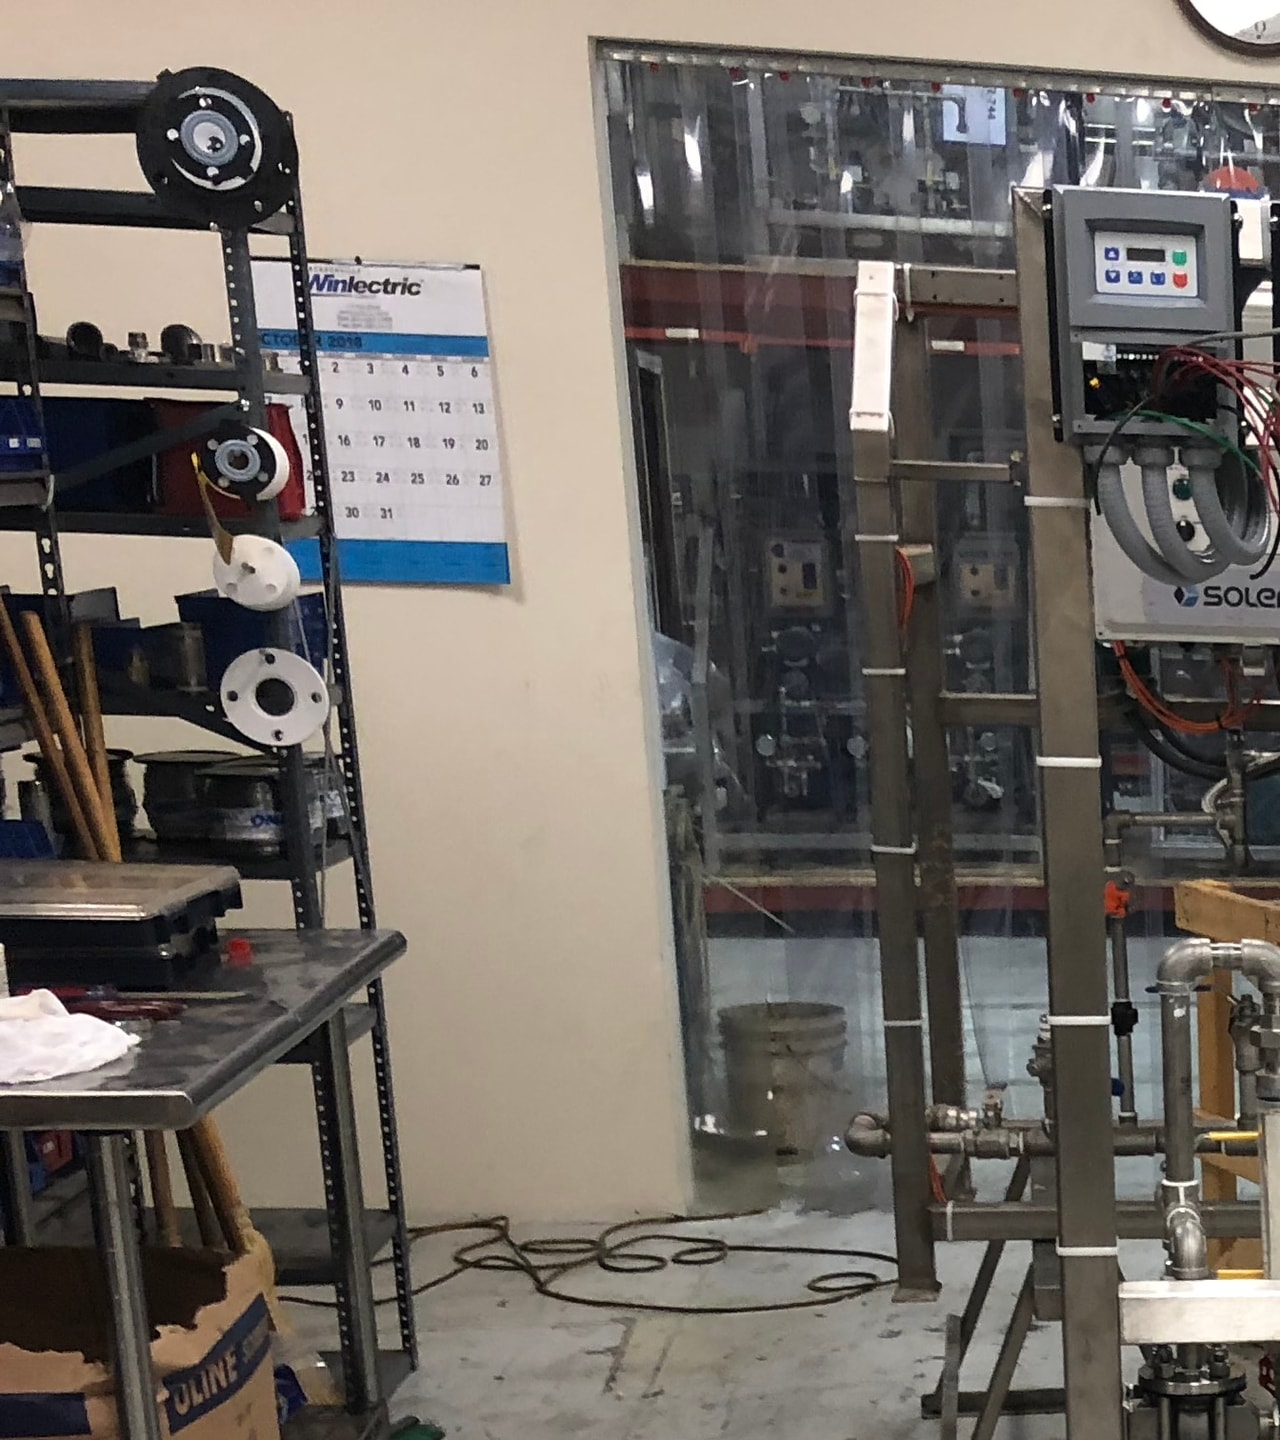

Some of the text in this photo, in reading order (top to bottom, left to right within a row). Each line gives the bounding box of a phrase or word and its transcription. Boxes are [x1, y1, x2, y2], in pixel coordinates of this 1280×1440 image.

[309, 274, 422, 296] Winlectric
[332, 362, 478, 378] 2 3 4 5 6
[336, 398, 485, 414] 9 10 11 12 13
[338, 435, 350, 446] 16
[373, 436, 385, 447] 17
[408, 437, 420, 448] 18
[443, 438, 455, 449] 19
[475, 439, 488, 450] 20
[342, 471, 355, 482] 23
[376, 472, 390, 483] 24
[411, 473, 424, 484] 25
[446, 474, 459, 485] 26
[479, 475, 491, 486] 27
[346, 507, 393, 519] 30 31
[173, 1350, 239, 1416] ULINE
